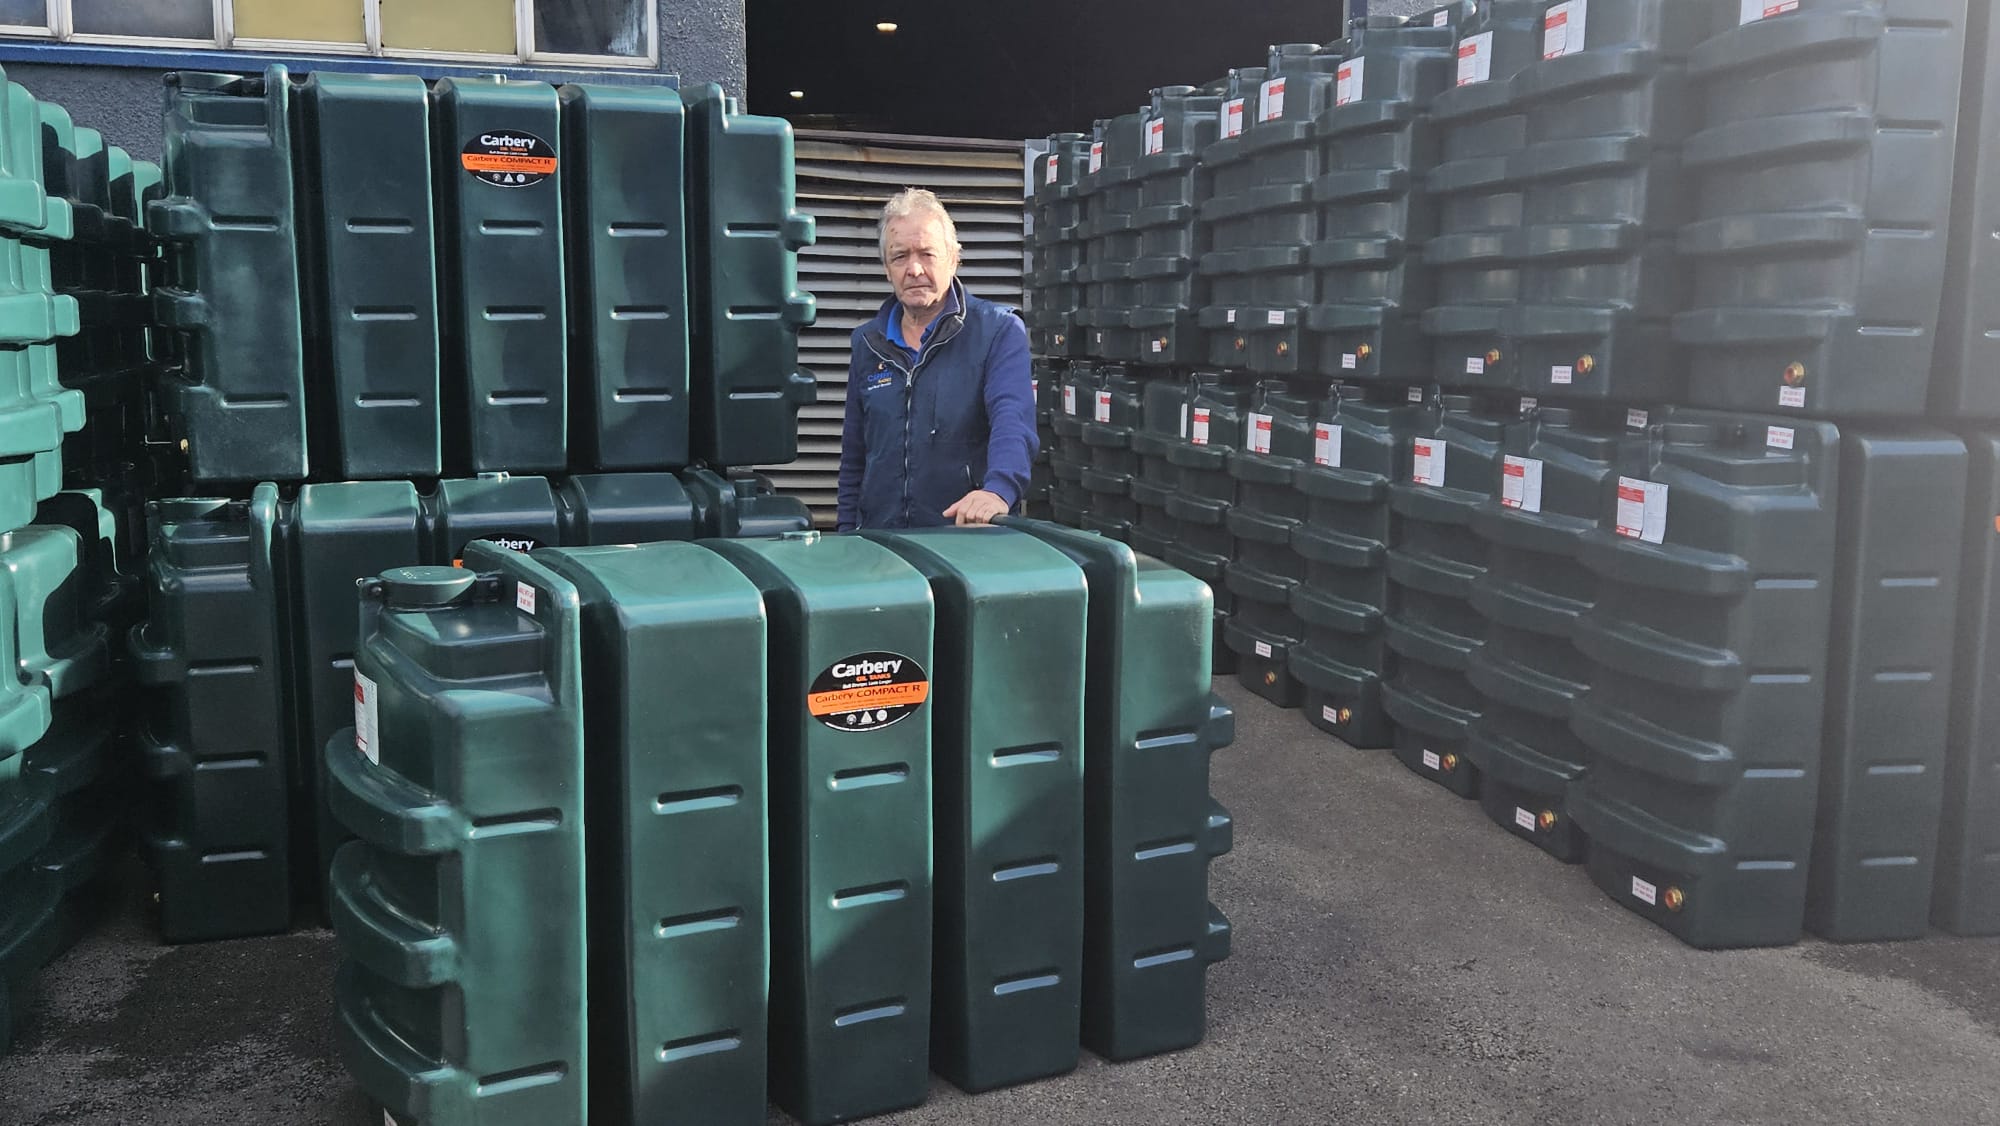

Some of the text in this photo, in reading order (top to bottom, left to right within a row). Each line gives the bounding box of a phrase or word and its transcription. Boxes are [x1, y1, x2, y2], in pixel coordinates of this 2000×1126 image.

[480, 134, 536, 149] Carbery
[466, 155, 498, 163] Carbery
[500, 155, 541, 165] COMPACT
[489, 538, 535, 551] rbery
[832, 659, 902, 678] Carbery
[815, 692, 853, 703] Carbery
[856, 685, 909, 698] COMPACT
